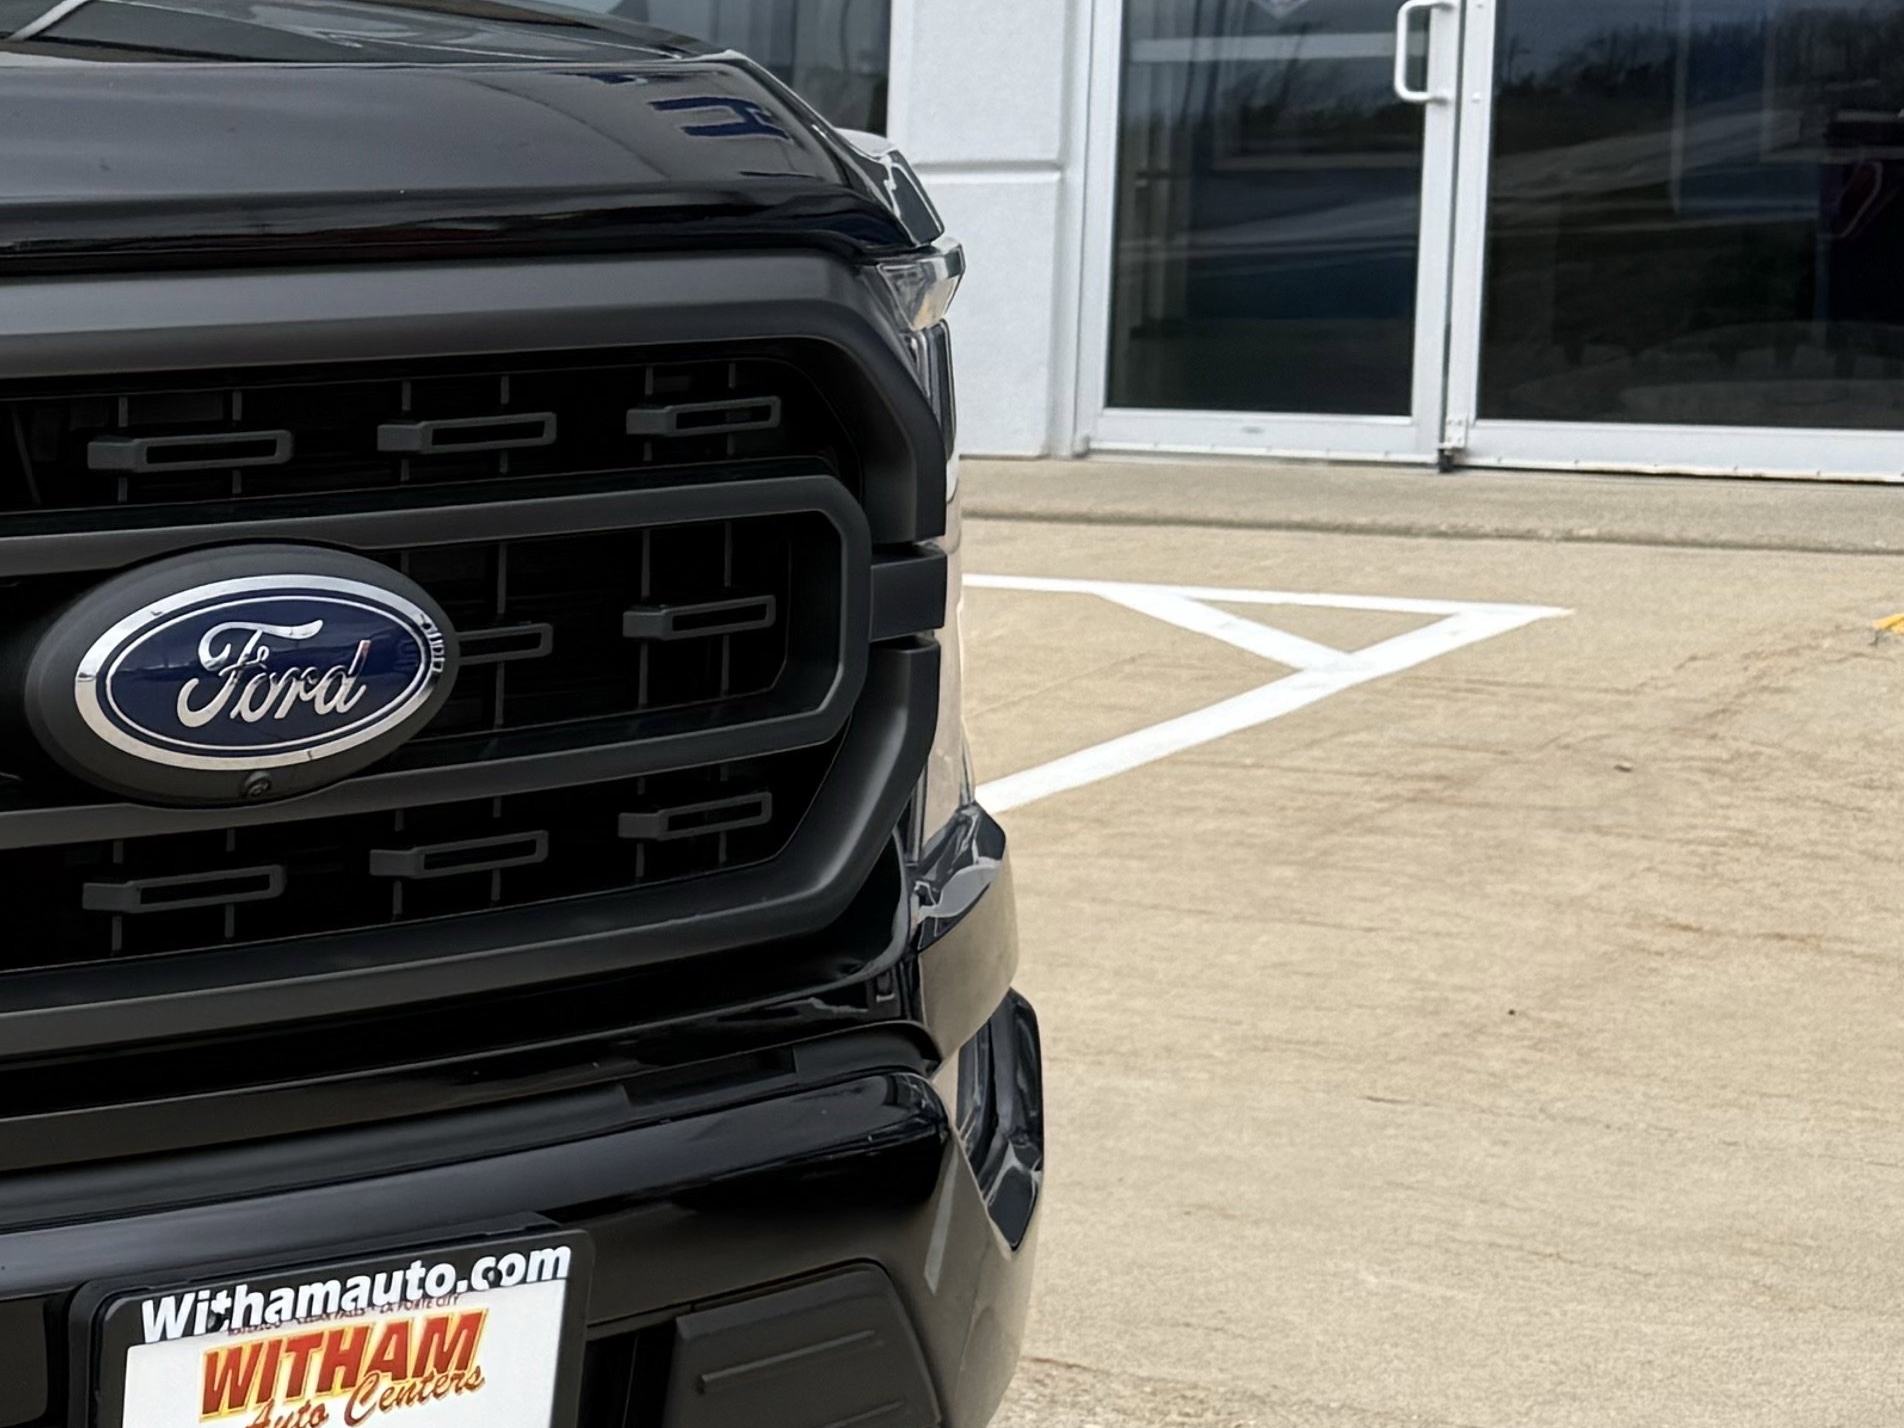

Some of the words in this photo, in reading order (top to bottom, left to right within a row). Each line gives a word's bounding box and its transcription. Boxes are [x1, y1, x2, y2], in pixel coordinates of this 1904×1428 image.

[177, 619, 371, 727] Ford
[142, 1244, 572, 1344] Withamauto.com
[200, 1310, 487, 1419] WITHAM
[343, 1364, 485, 1428] Centers
